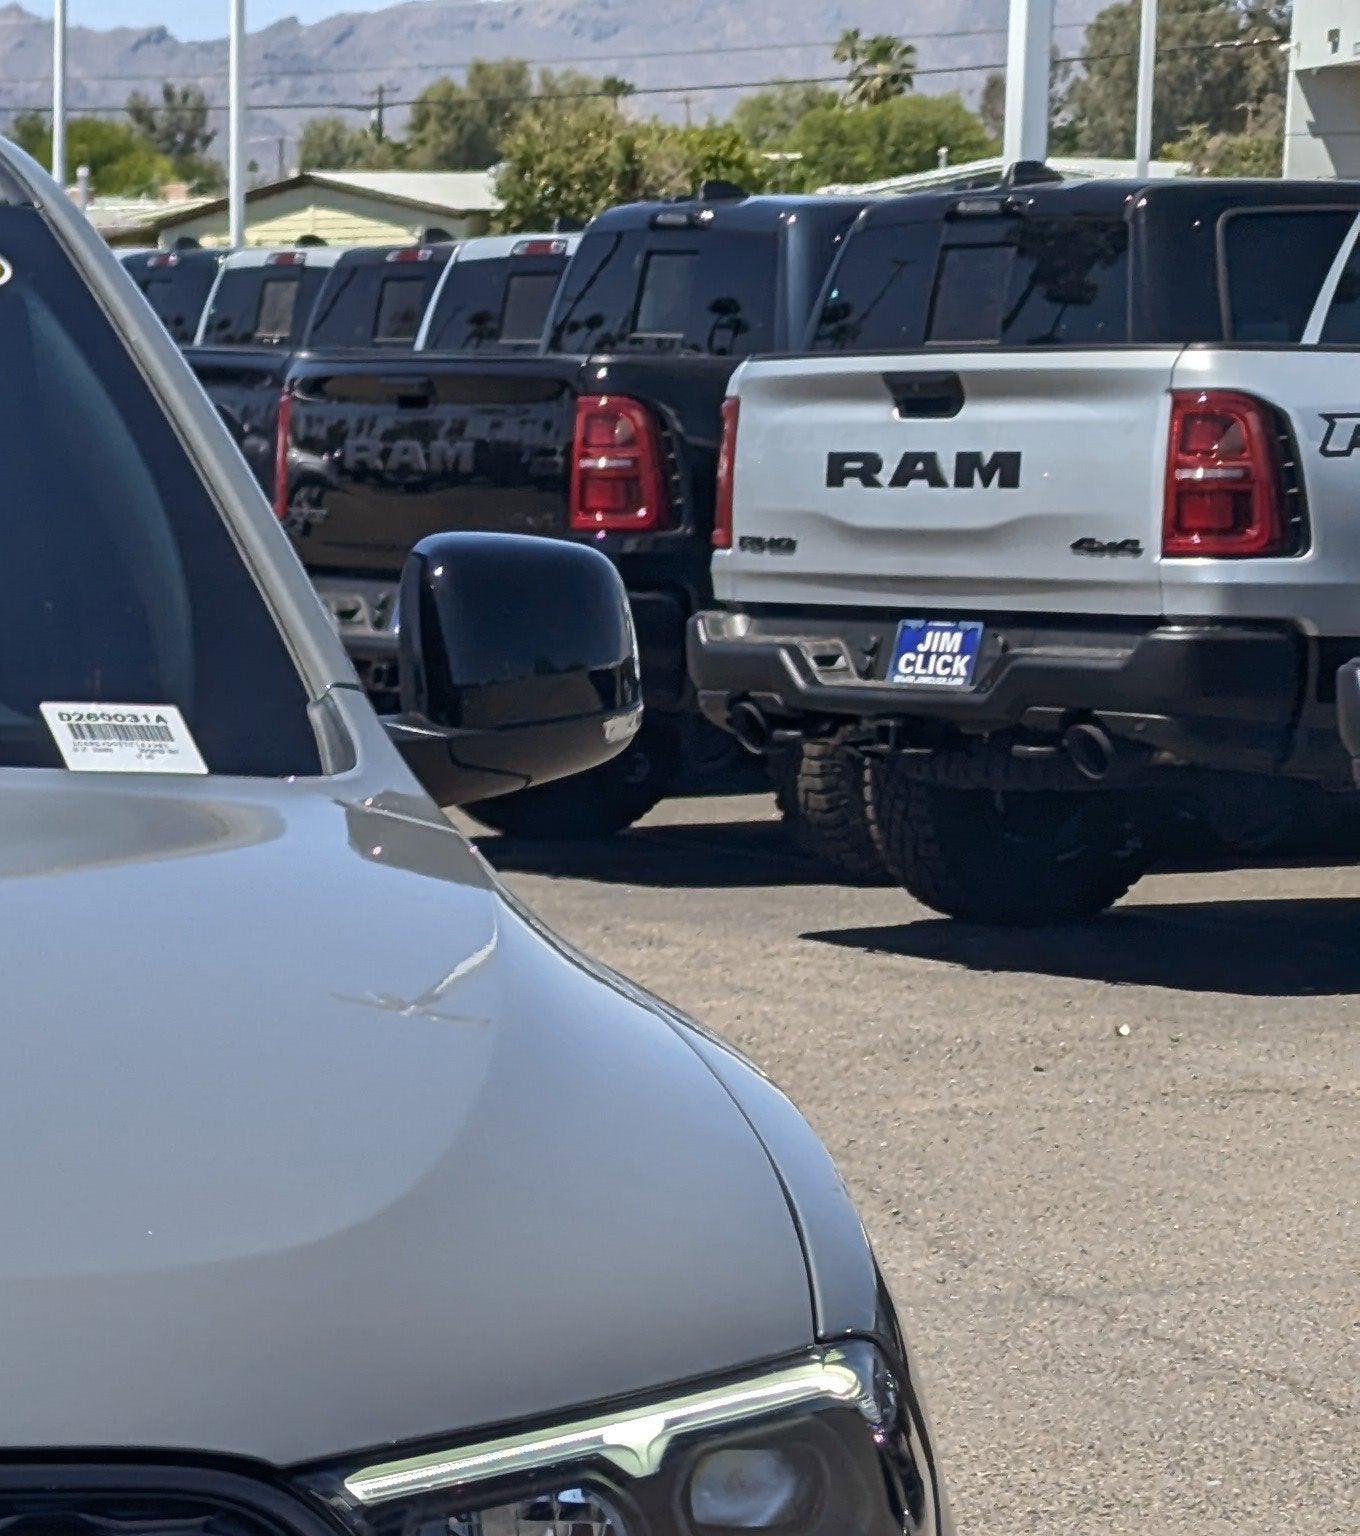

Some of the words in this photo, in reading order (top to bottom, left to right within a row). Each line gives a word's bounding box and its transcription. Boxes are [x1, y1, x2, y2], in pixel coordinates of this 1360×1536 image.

[344, 439, 475, 473] RAM
[826, 451, 1022, 489] RAM
[917, 631, 963, 653] JIM
[897, 652, 971, 676] CLICK
